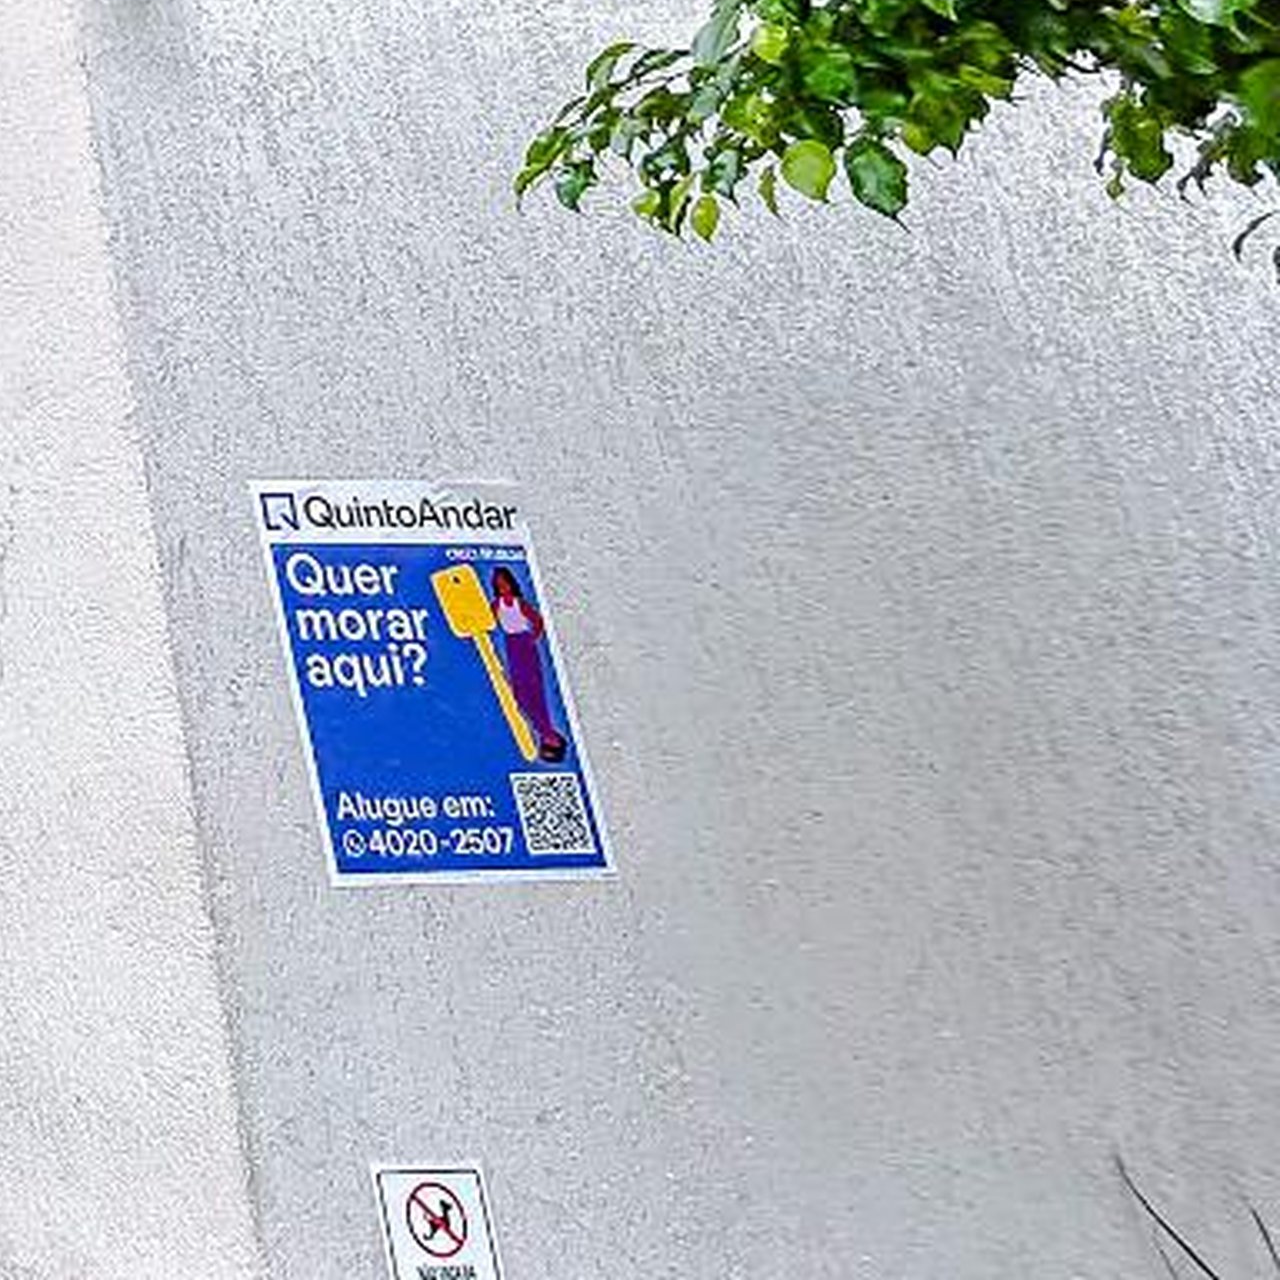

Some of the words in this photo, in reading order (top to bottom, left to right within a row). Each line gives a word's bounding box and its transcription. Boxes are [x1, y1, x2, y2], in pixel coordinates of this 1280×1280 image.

[303, 495, 517, 530] QuintoAndar
[285, 552, 398, 596] Quer
[294, 608, 430, 642] morar
[305, 643, 428, 697] aqui?
[336, 791, 438, 826] Alugue
[442, 795, 494, 818] em:
[369, 827, 514, 855] 4020-2507
